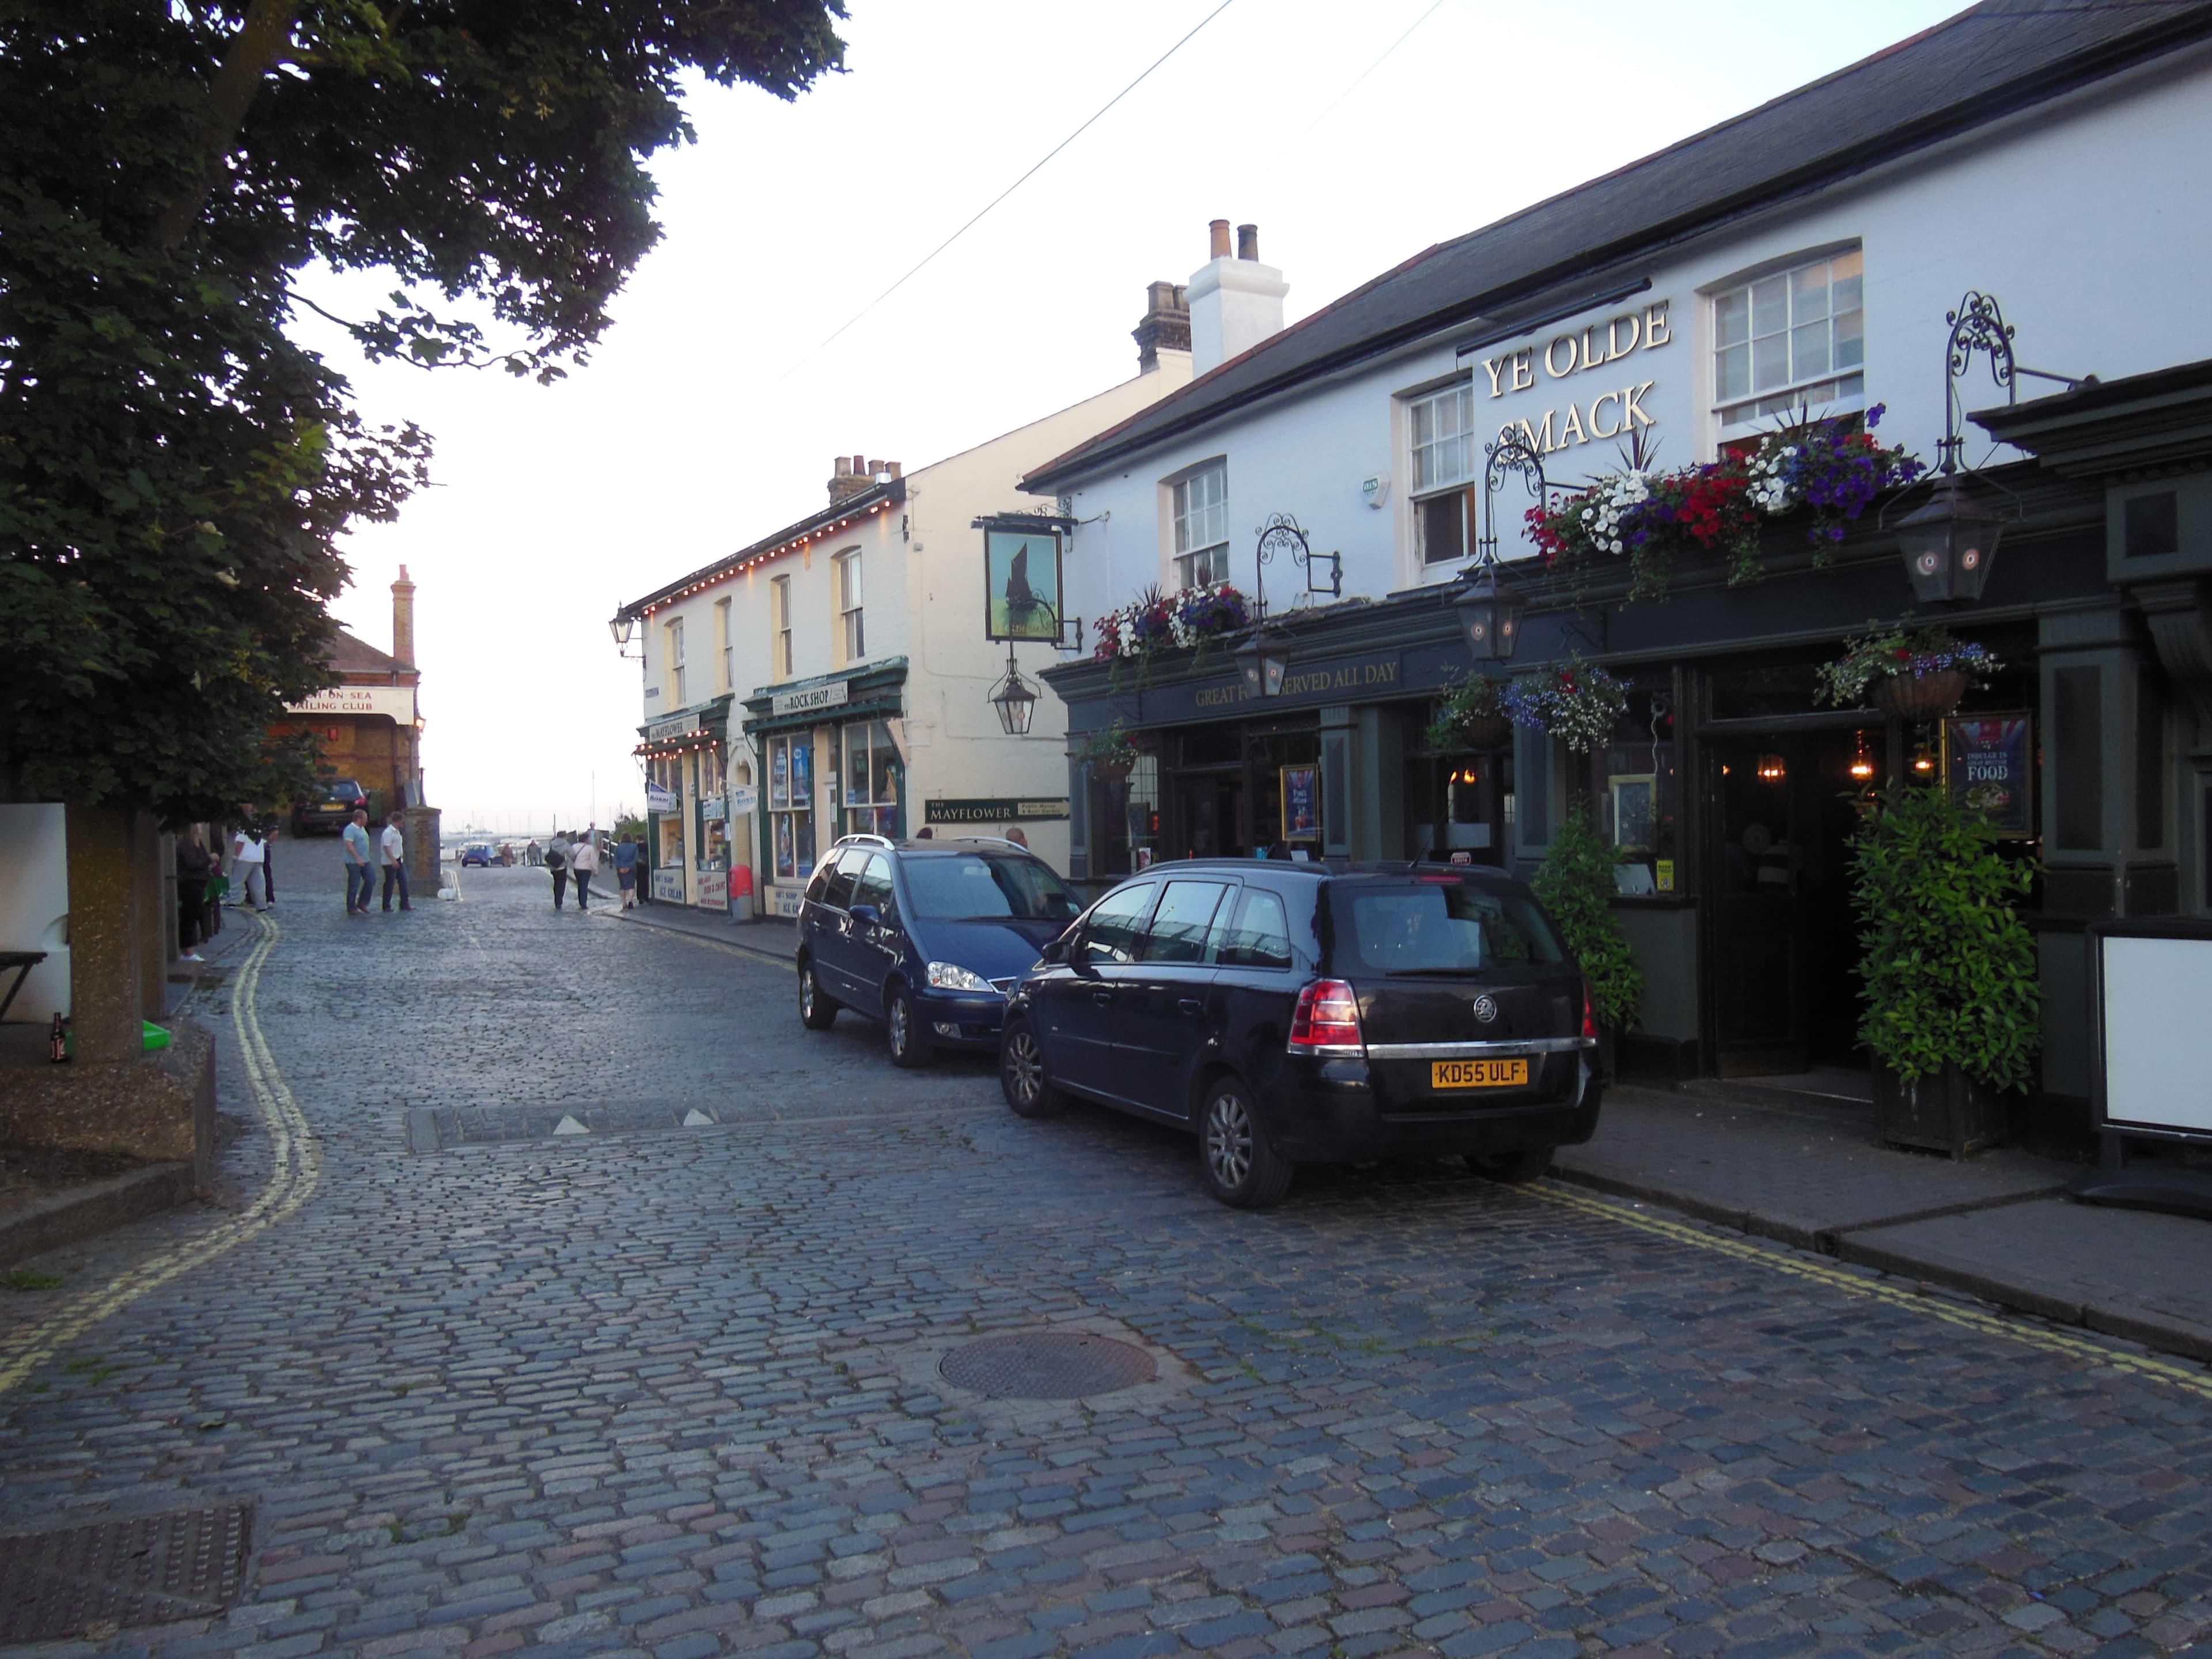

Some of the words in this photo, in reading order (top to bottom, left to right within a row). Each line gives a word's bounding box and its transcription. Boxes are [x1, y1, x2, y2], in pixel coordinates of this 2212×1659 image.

[1481, 346, 1535, 398] YE
[1545, 299, 1671, 378] OLDE
[1498, 380, 1656, 464] SMACK
[1279, 671, 1330, 696] SERVED
[1334, 667, 1363, 688] ALL
[1364, 662, 1397, 685] DAY
[790, 694, 809, 710] ROCK
[810, 690, 829, 706] SHOP
[1195, 684, 1236, 706] GREAT
[656, 722, 684, 738] MAYFLOWER
[1968, 765, 2009, 781] FOOD
[931, 808, 1012, 820] MAYFLOWER
[1439, 1063, 1484, 1083] KD55
[1490, 1062, 1520, 1081] ULF
